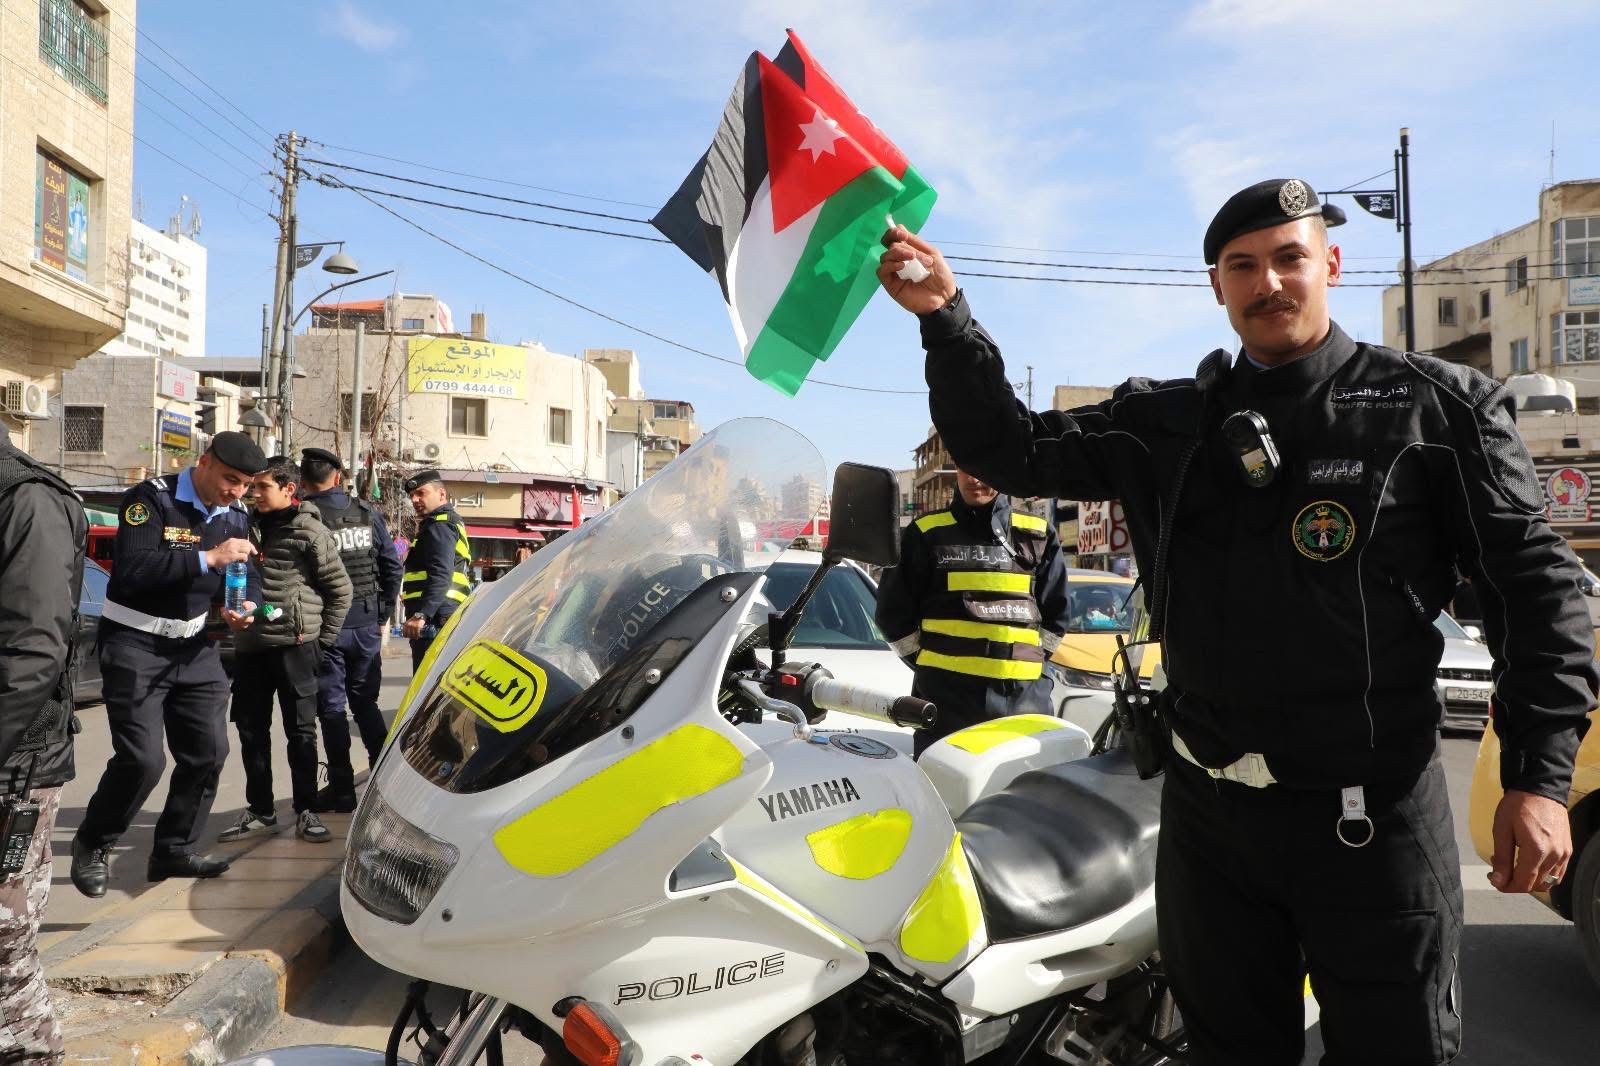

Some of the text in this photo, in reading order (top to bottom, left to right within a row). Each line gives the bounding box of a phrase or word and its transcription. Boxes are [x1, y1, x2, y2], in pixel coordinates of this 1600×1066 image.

[445, 342, 496, 360] الموقع
[425, 381, 513, 396] 0799 4444 68
[1332, 401, 1414, 409] TRAFFIC POLICE
[617, 582, 671, 651] POLICE
[979, 604, 1030, 615] Traffic Police
[454, 663, 527, 707] السير
[757, 776, 861, 823] YAMAHA
[613, 952, 786, 1006] POLICE
